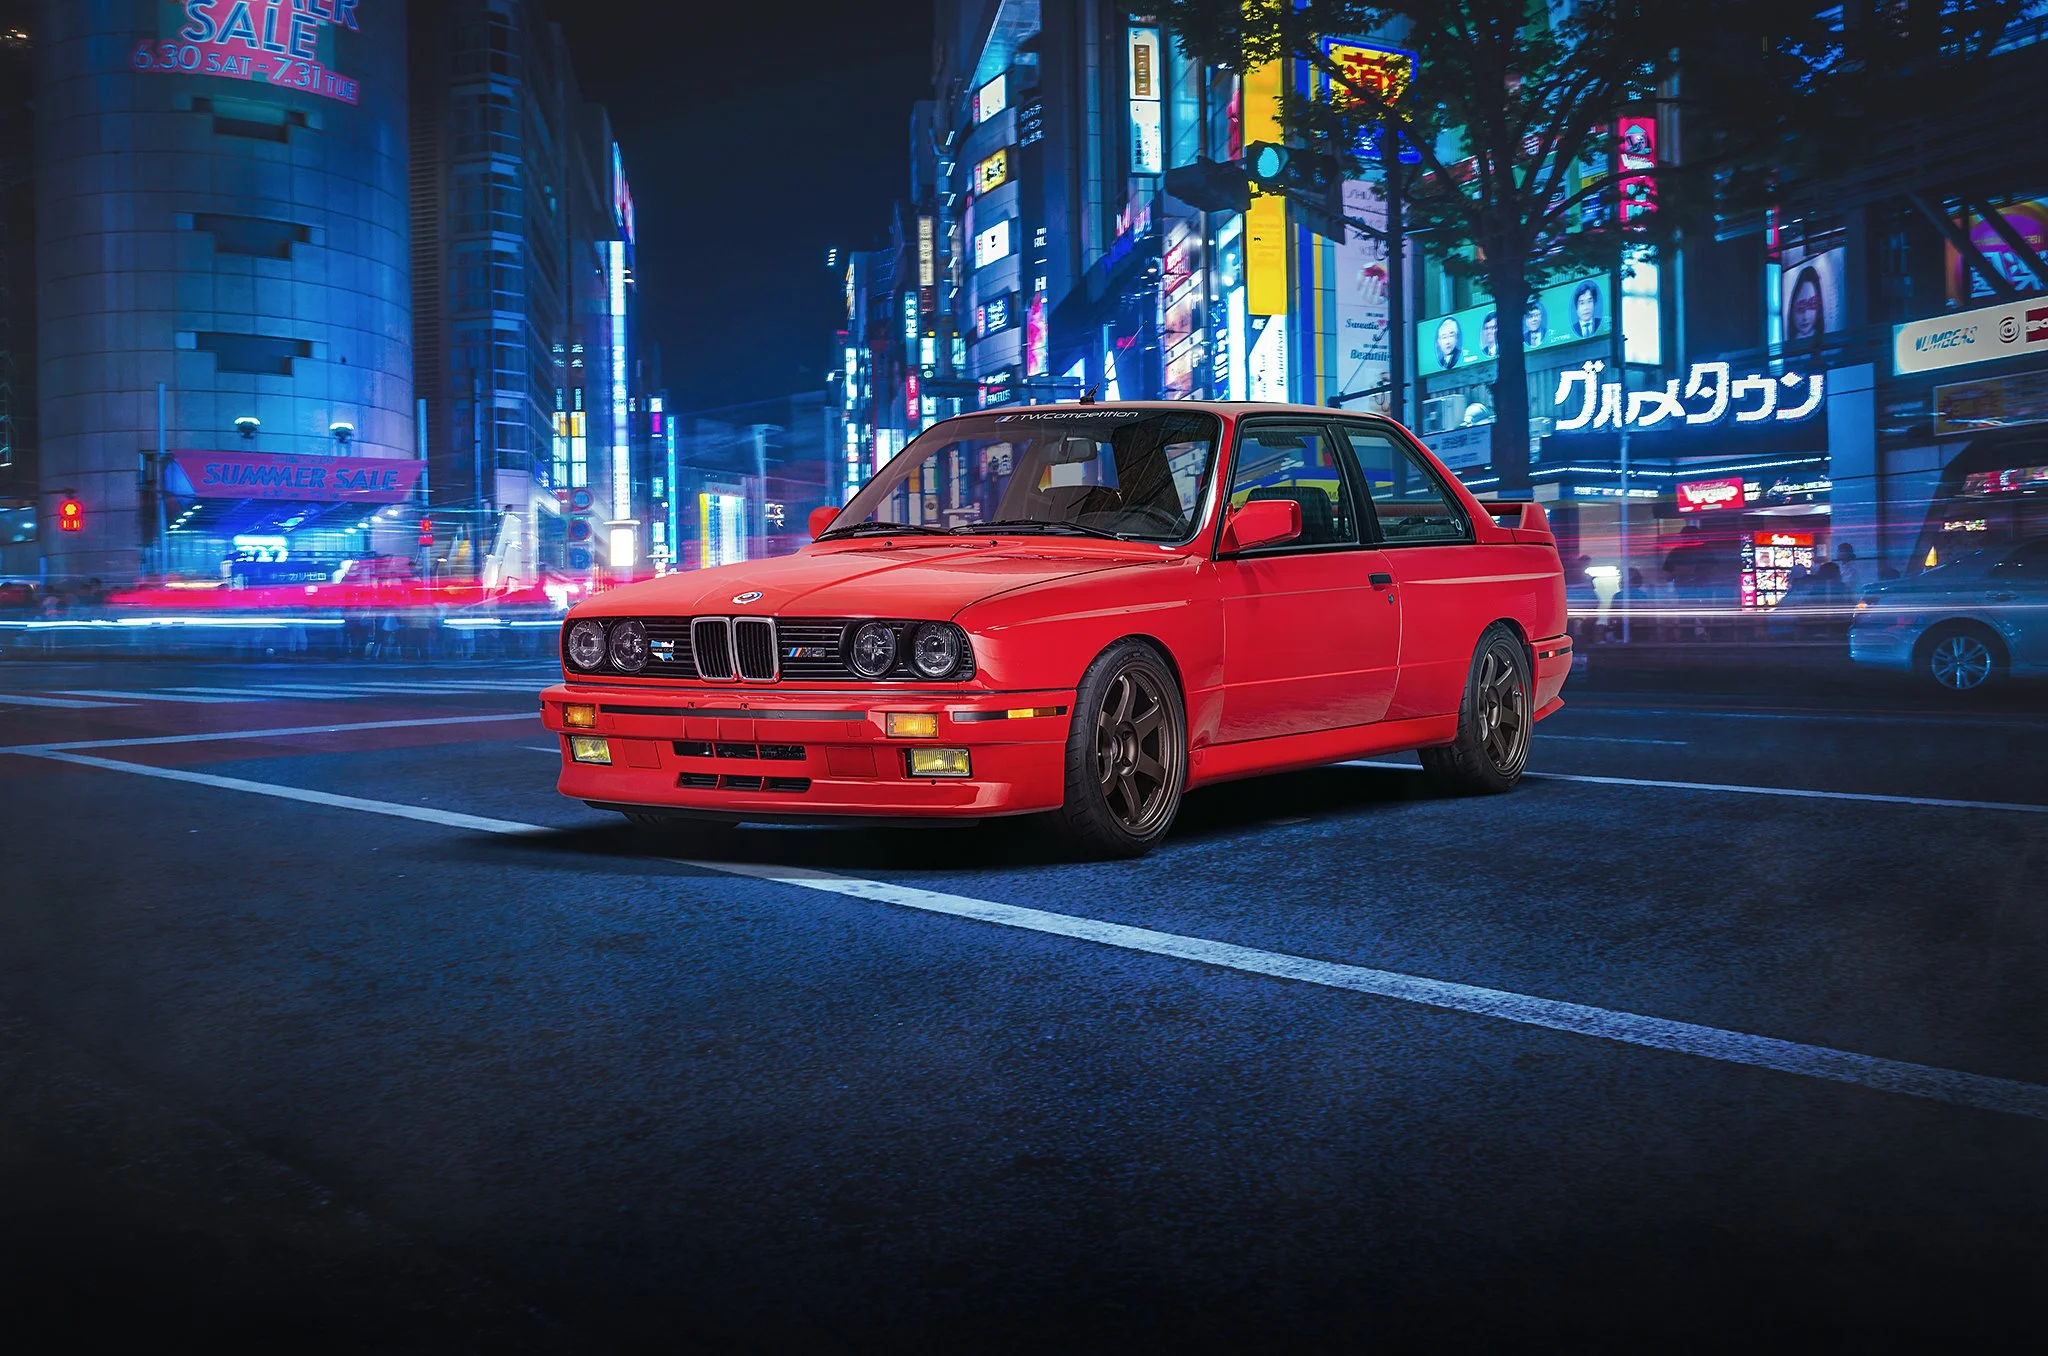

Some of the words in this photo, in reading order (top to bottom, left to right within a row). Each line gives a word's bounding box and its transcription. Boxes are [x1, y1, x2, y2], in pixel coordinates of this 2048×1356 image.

[181, 0, 318, 61] SALE
[134, 43, 201, 70] 6.30
[206, 53, 251, 75] SAT
[273, 56, 320, 89] 7.31
[325, 74, 357, 100] TUE
[1915, 326, 1978, 351] NUMBERS
[1555, 360, 1824, 430] グルメタウン
[1020, 411, 1139, 421] TWCompetition
[203, 463, 327, 490] SUMMER
[333, 468, 399, 491] SALE
[799, 647, 825, 657] M3
